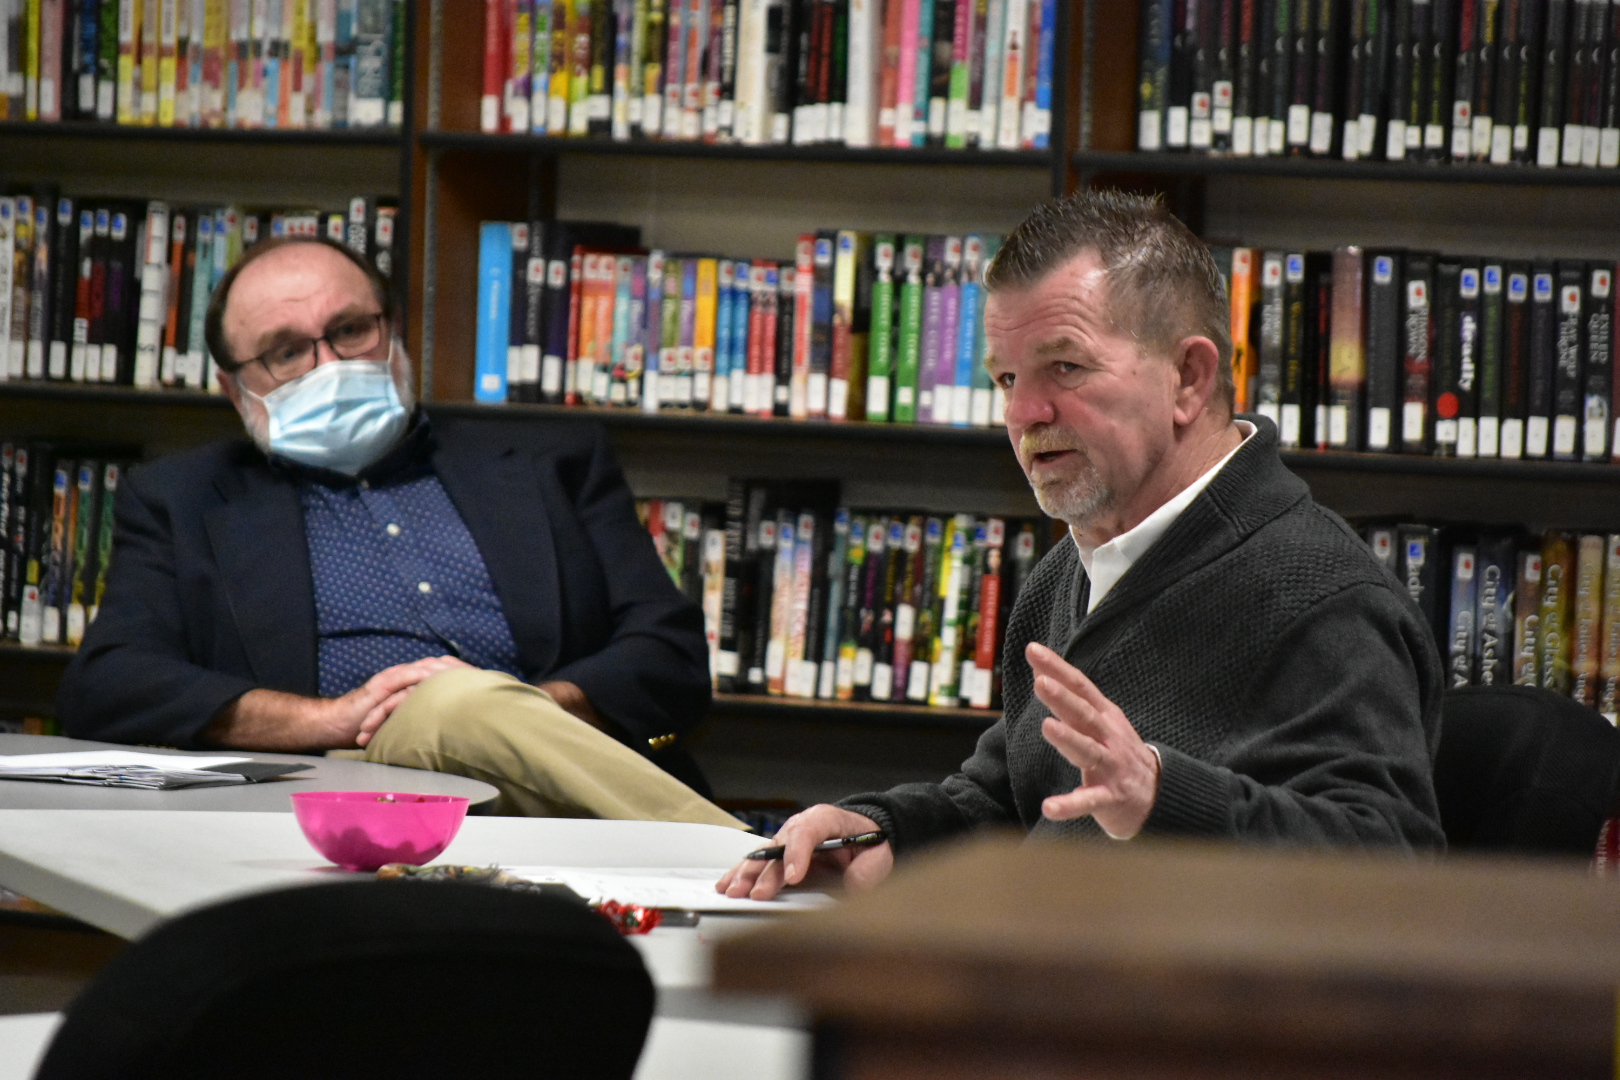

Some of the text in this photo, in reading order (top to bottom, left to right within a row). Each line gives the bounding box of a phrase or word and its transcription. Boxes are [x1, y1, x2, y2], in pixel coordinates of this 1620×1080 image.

[1405, 313, 1419, 357] ROWN
[1415, 306, 1429, 364] RIMSON
[1457, 315, 1477, 391] deadly
[1588, 313, 1601, 362] QUEEN
[1543, 564, 1563, 606] City
[1576, 563, 1594, 597] City
[1453, 611, 1473, 652] City
[1481, 565, 1501, 686] City of Ashe
[1521, 614, 1540, 657] City
[1452, 655, 1469, 671] of
[1543, 632, 1561, 687] Glass
[1573, 672, 1592, 703] Ange
